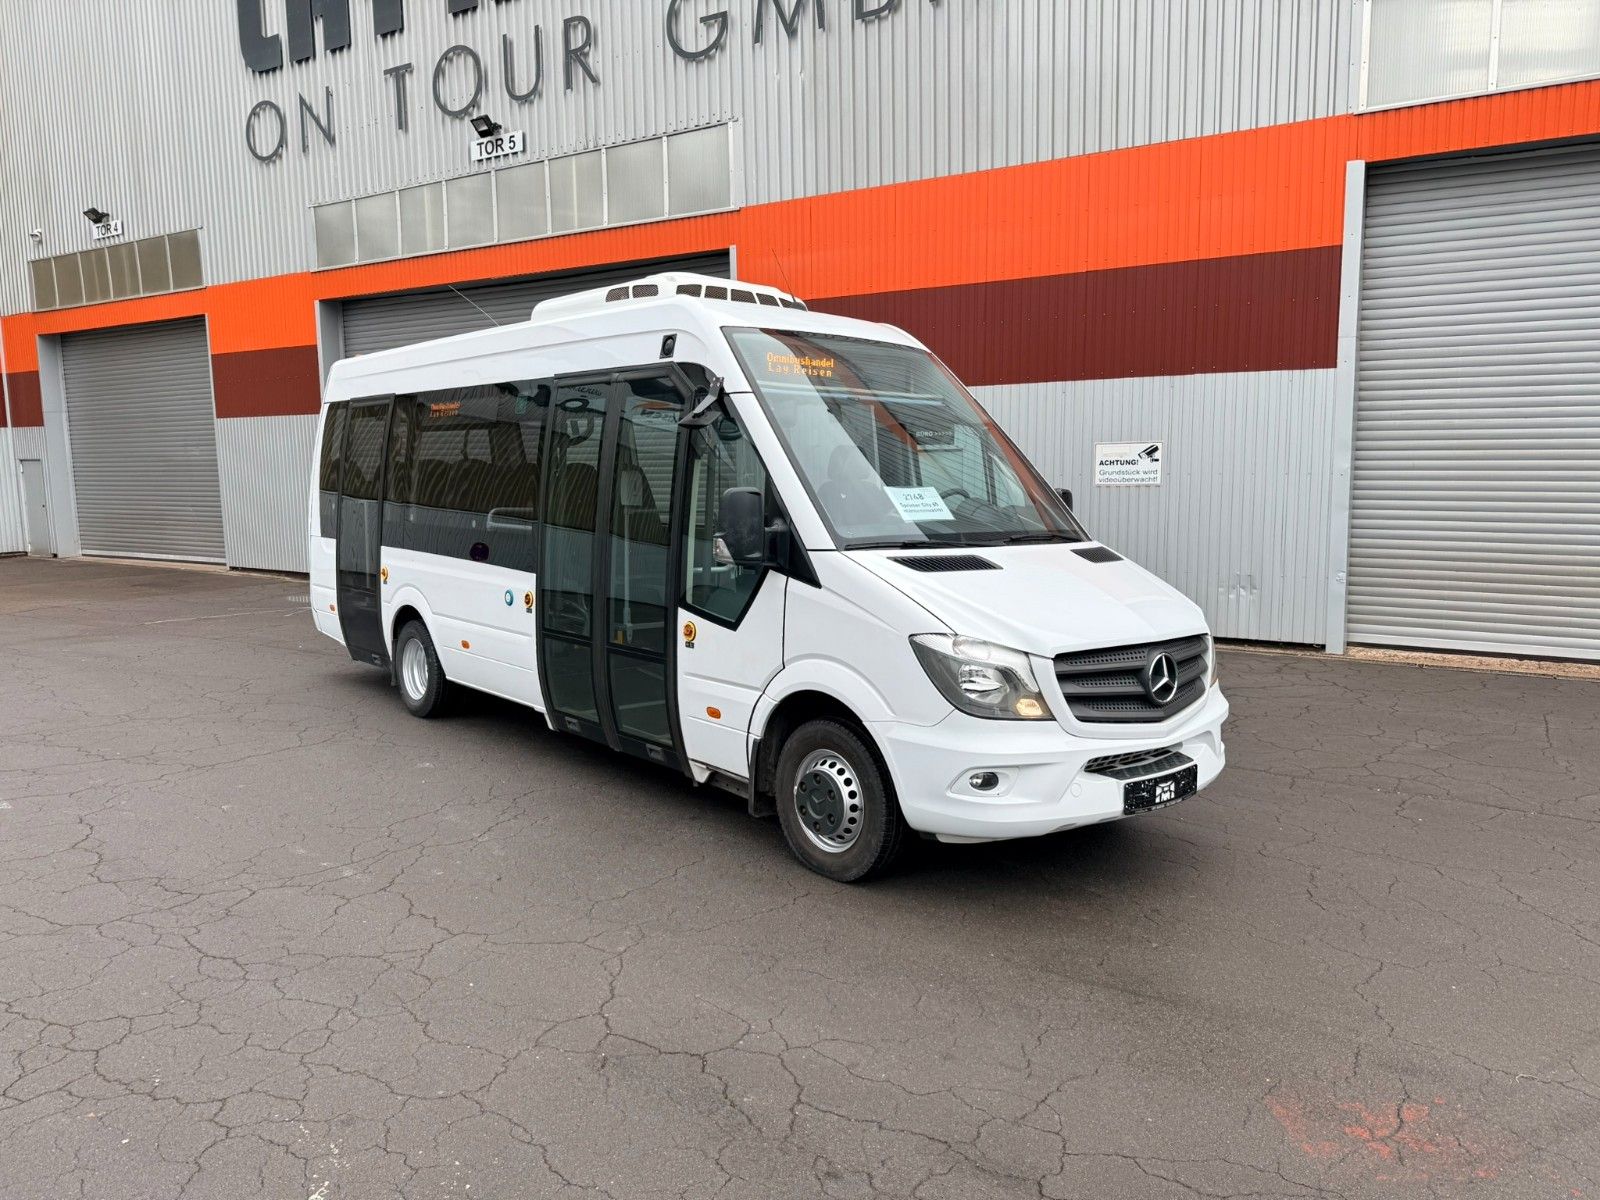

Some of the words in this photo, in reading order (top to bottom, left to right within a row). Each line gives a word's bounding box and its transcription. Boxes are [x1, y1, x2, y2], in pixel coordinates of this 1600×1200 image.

[246, 86, 335, 162] ON
[383, 15, 599, 130] TOUR
[477, 137, 505, 157] TOR
[508, 135, 516, 150] 5
[95, 223, 112, 237] TOR
[113, 221, 118, 233] 4
[766, 352, 835, 368] Omnibushandel
[767, 362, 789, 374] Lay
[793, 364, 832, 377] Reisen
